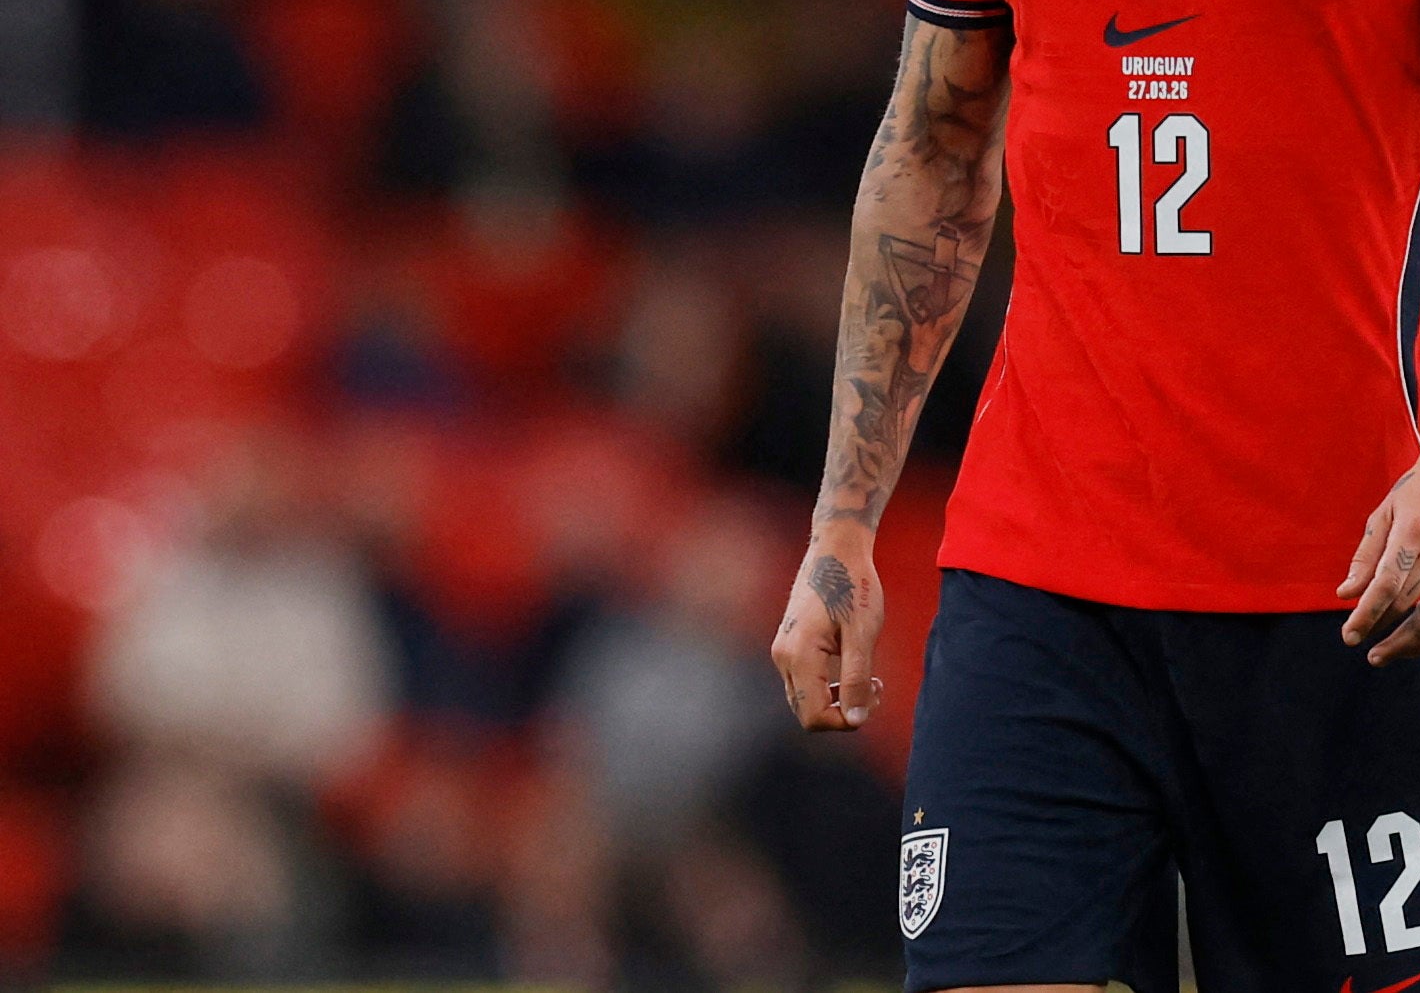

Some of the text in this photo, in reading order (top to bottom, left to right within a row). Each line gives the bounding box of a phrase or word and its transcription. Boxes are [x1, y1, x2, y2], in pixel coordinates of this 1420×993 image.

[1121, 56, 1194, 75] URUGUAY
[1128, 80, 1188, 99] 27.03.26
[1108, 113, 1212, 255] 12
